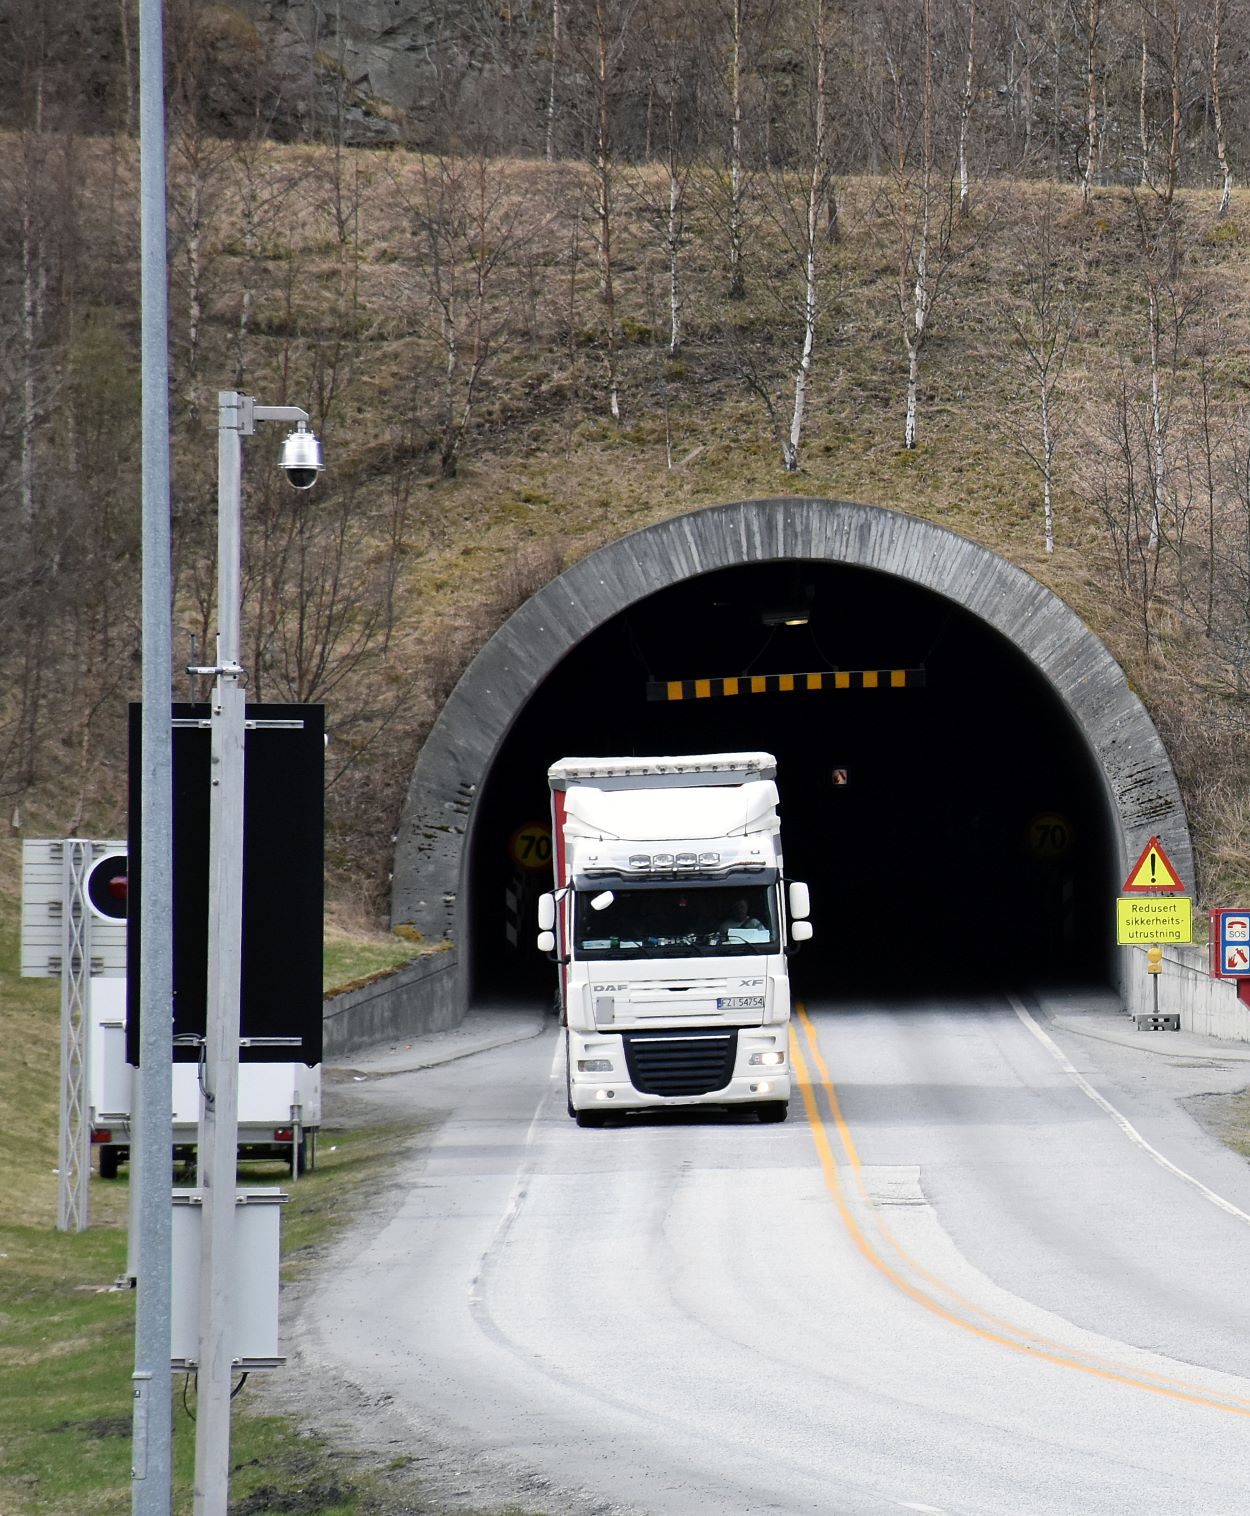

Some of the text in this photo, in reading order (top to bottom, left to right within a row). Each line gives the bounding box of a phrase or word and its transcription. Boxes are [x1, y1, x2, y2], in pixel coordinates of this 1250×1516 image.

[520, 835, 551, 861] 70
[1131, 903, 1177, 913] Redusert
[1125, 916, 1184, 926] sikkerheits-
[1128, 929, 1181, 940] utrustning
[1229, 930, 1247, 938] SOS
[593, 984, 628, 992] DAF
[739, 979, 765, 987] XF
